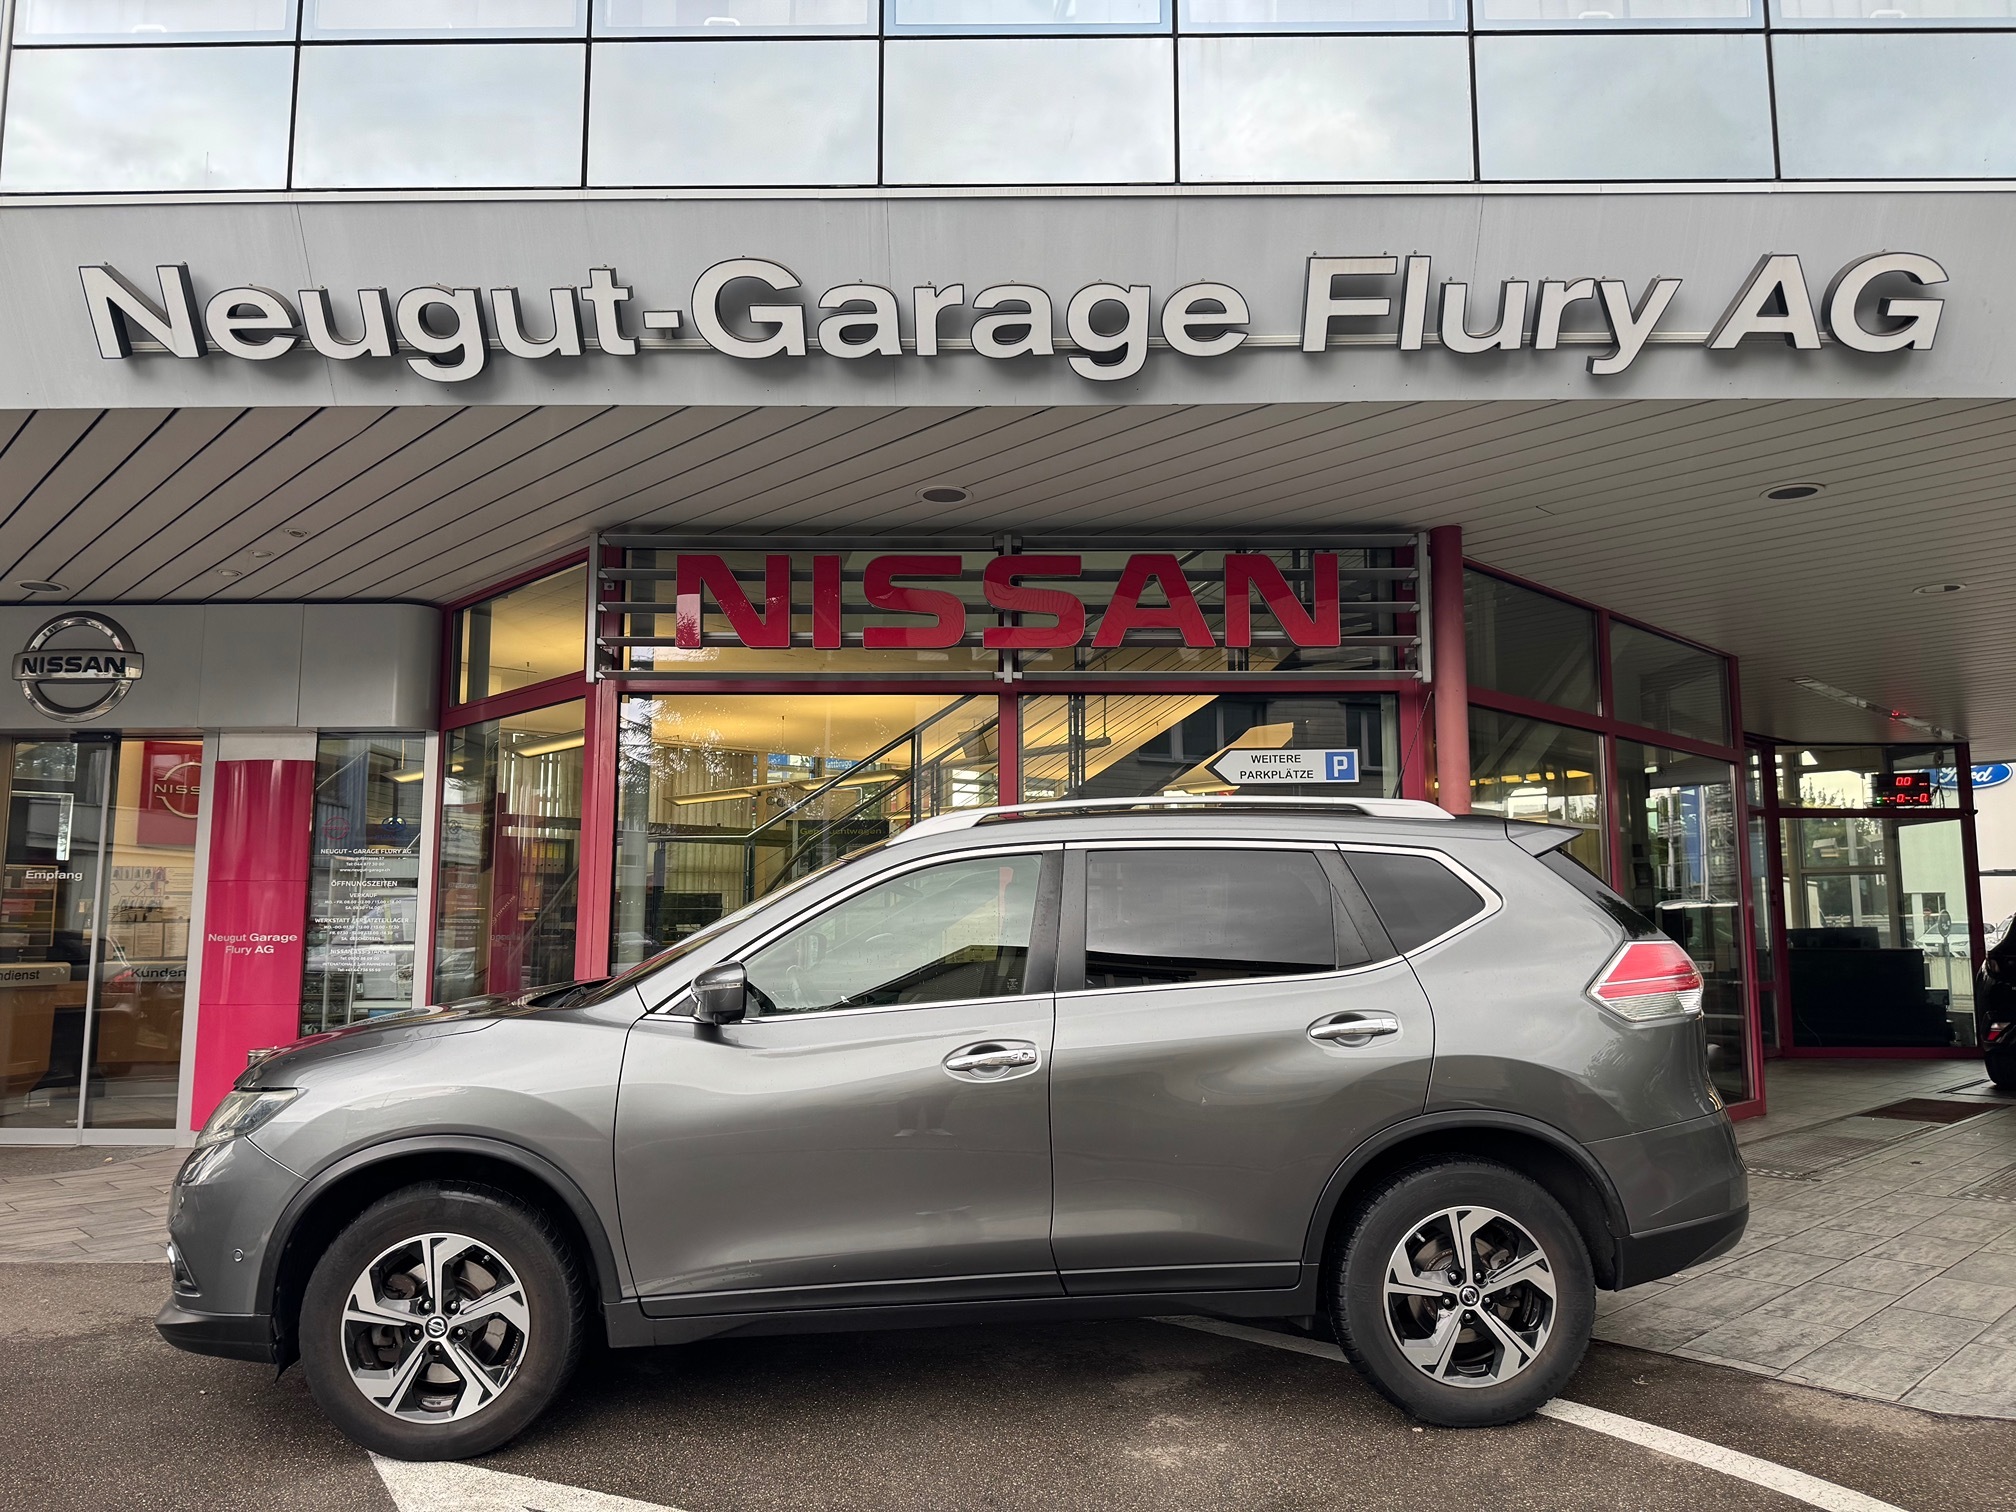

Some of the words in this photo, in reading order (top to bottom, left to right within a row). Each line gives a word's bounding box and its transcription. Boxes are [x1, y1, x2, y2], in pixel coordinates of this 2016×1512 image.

[77, 257, 1250, 384] Neugut-Garage
[1301, 254, 1684, 376] Flury
[1703, 251, 1949, 354] AG
[674, 552, 1342, 650] NISSAN
[20, 656, 127, 675] NISSAN
[1250, 754, 1302, 764] WEITERE
[1239, 768, 1315, 780] PARKPLÄTZE
[154, 783, 201, 795] NISS
[25, 870, 83, 882] Empfang
[331, 879, 398, 887] ÖFFNUNGSZEITEN
[208, 934, 247, 943] Neugut
[249, 933, 298, 943] Garage
[225, 945, 252, 956] Flury
[254, 945, 274, 954] AG
